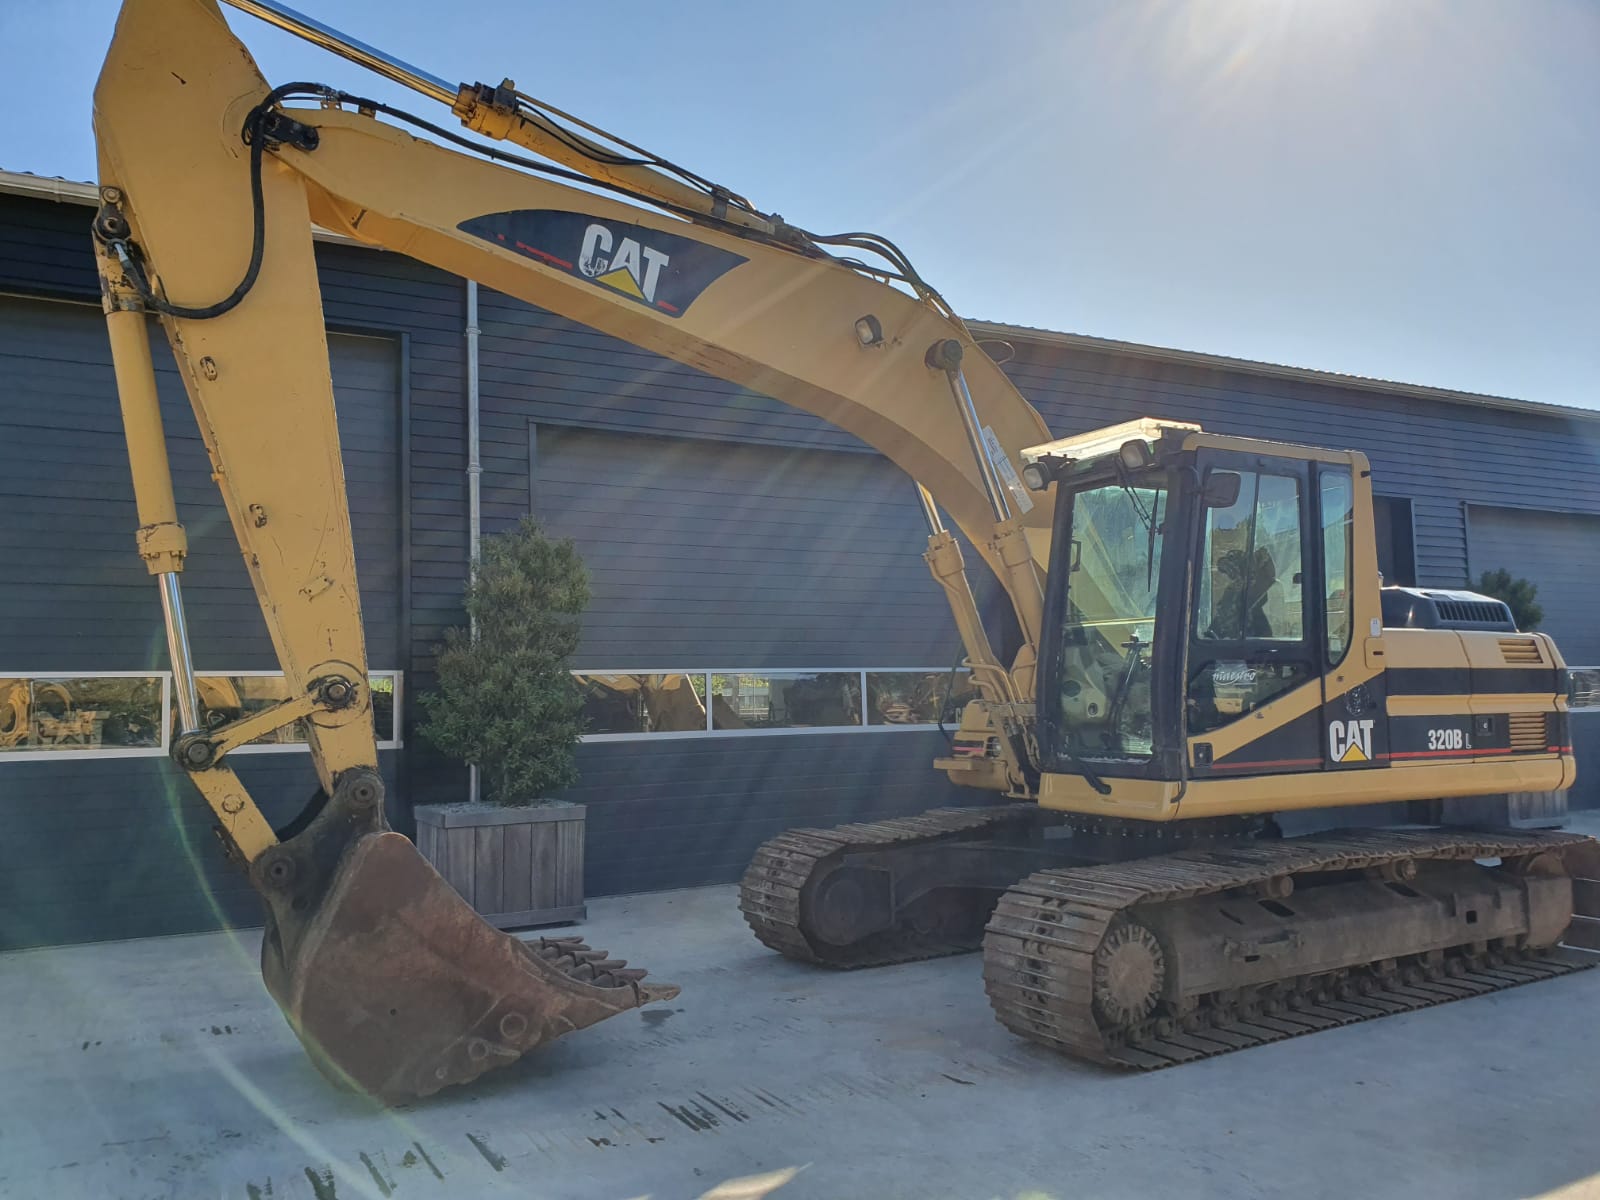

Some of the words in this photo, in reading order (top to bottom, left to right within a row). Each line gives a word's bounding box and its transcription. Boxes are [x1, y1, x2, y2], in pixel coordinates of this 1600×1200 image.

[578, 223, 669, 303] CAT
[1329, 719, 1374, 762] CAT
[1428, 729, 1462, 750] 320B
